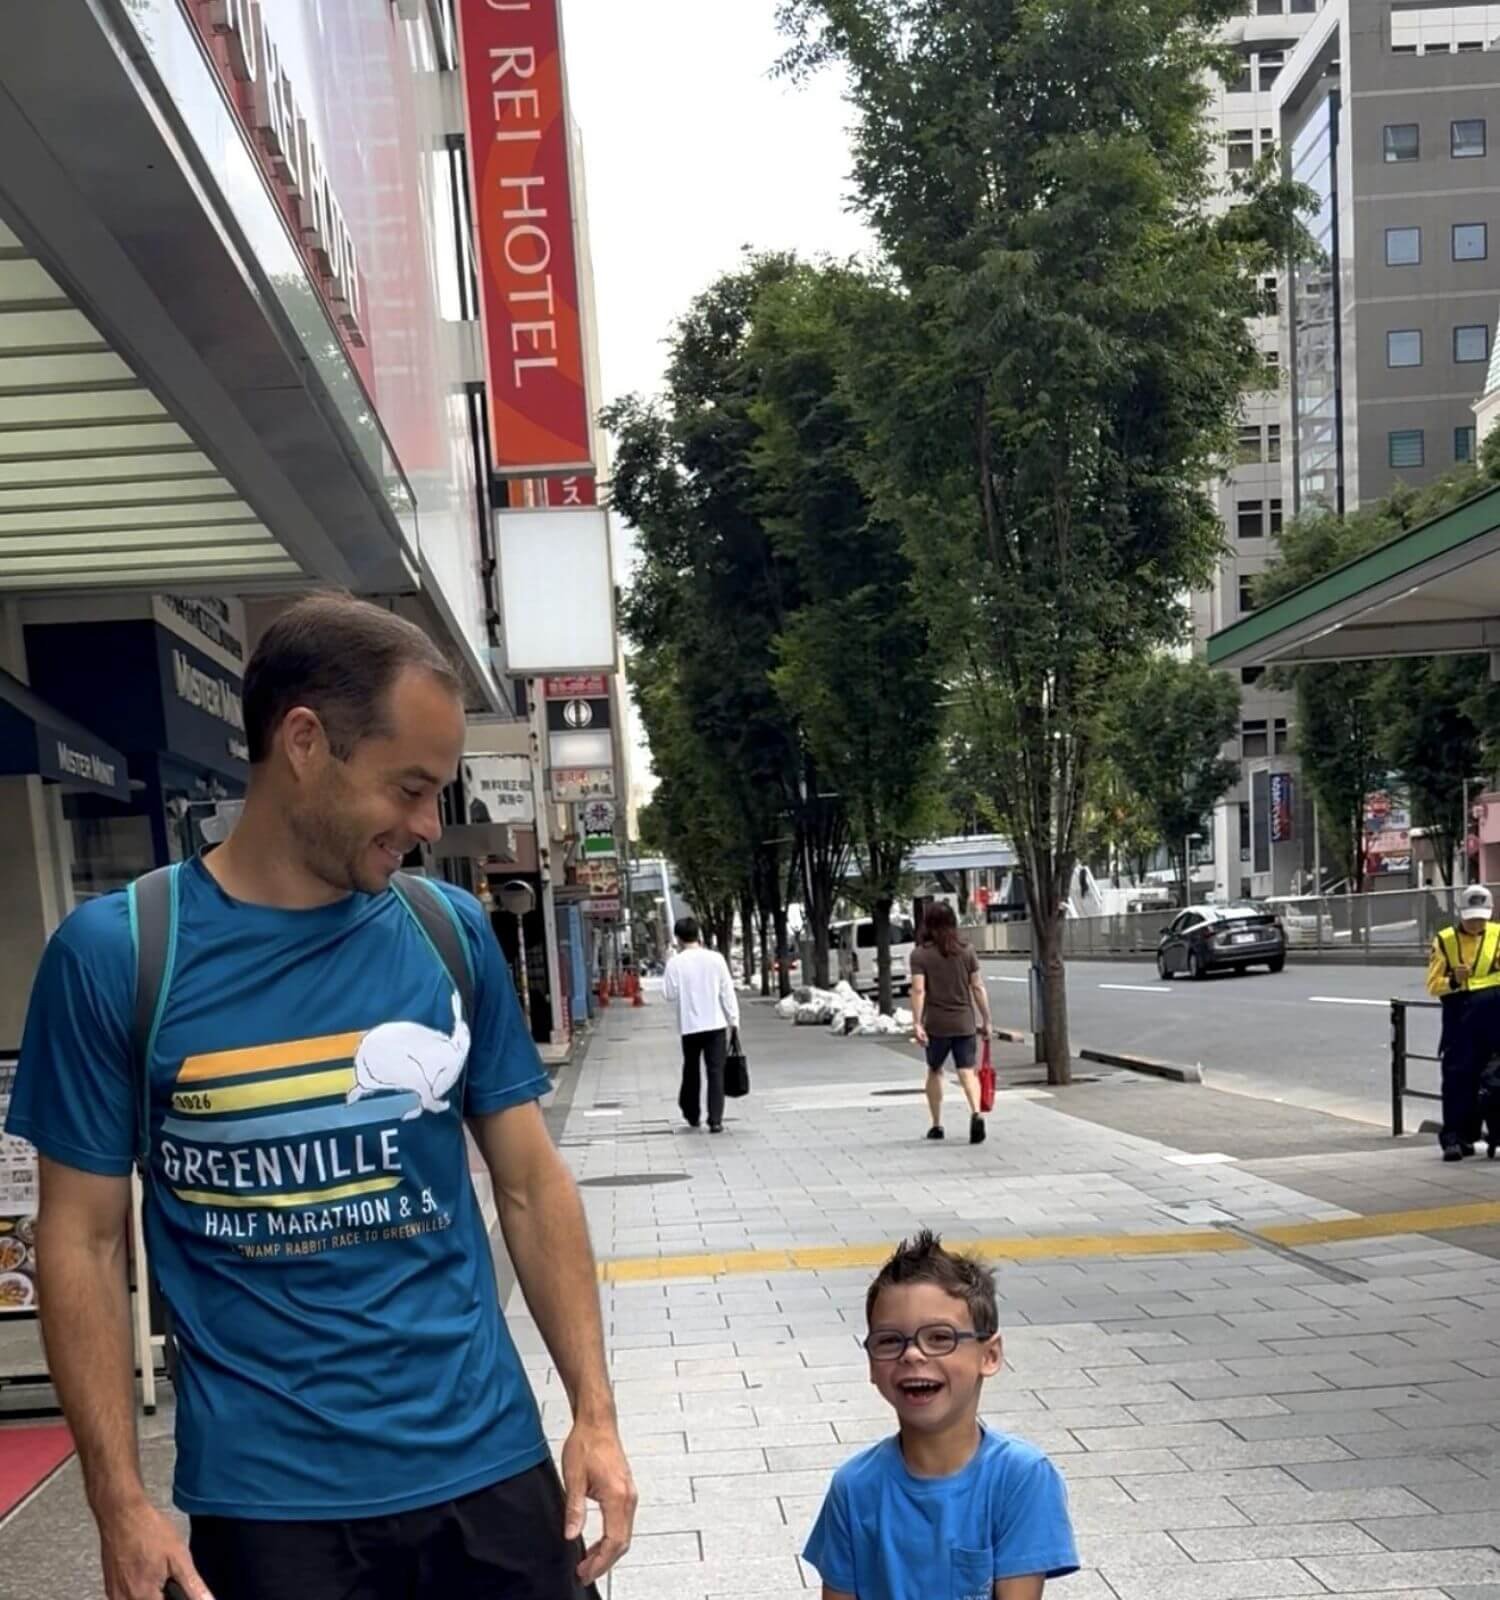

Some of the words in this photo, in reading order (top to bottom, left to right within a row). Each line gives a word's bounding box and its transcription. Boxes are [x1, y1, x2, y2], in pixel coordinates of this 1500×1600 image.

[489, 46, 542, 141] REI
[500, 176, 558, 388] HOTEL
[161, 1128, 402, 1188] GREENVILLE
[205, 1211, 257, 1237] HALF
[267, 1197, 391, 1236] MARATHON
[399, 1195, 413, 1218] &
[285, 1238, 327, 1257] RABBIT
[331, 1231, 361, 1249] RACE
[365, 1229, 379, 1243] TO
